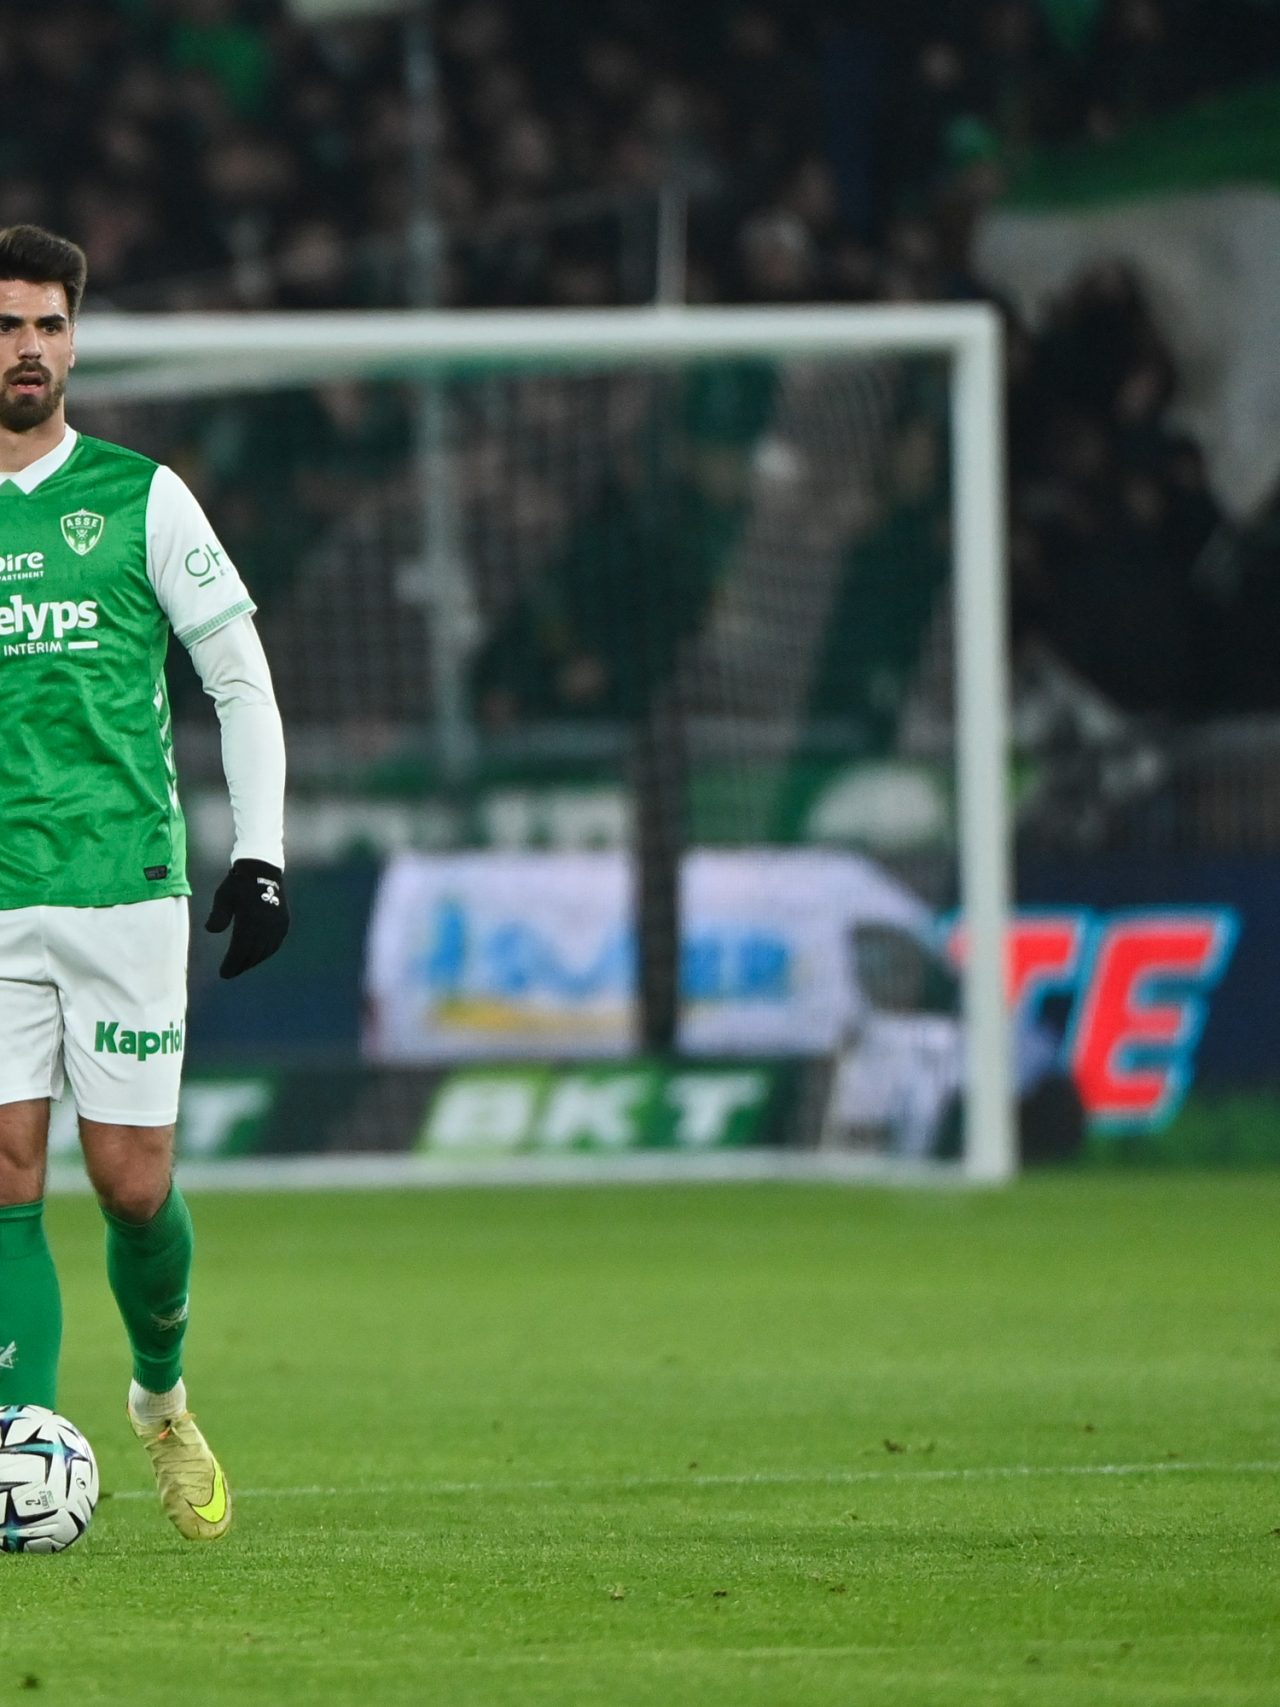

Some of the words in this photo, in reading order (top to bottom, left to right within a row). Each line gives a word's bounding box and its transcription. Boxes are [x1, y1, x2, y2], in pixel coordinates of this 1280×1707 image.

[66, 517, 99, 528] ASSE
[4, 641, 63, 656] INTERIM
[422, 1068, 762, 1156] BKT
